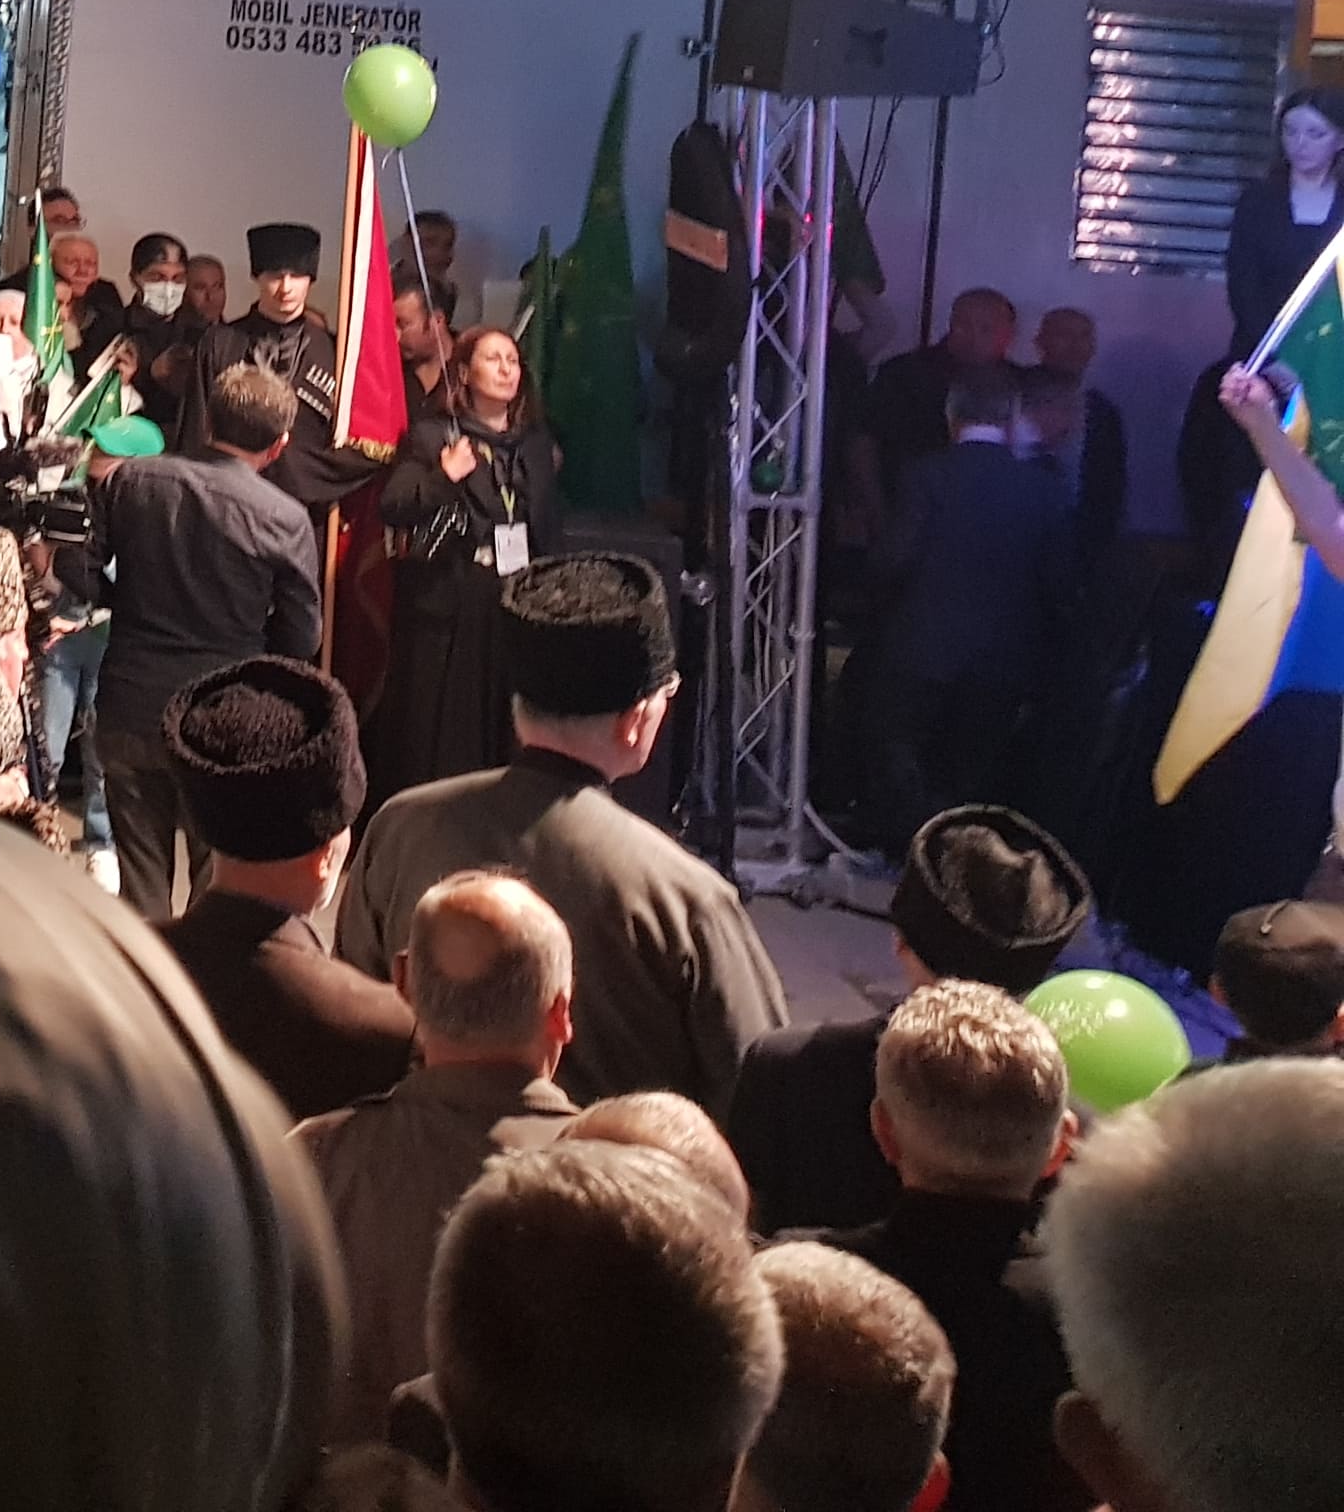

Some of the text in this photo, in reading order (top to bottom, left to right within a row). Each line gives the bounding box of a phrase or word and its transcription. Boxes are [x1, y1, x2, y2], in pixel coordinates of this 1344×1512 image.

[300, 1, 422, 34] JENERATÖR
[226, 26, 288, 53] 0533
[296, 30, 342, 56] 483
